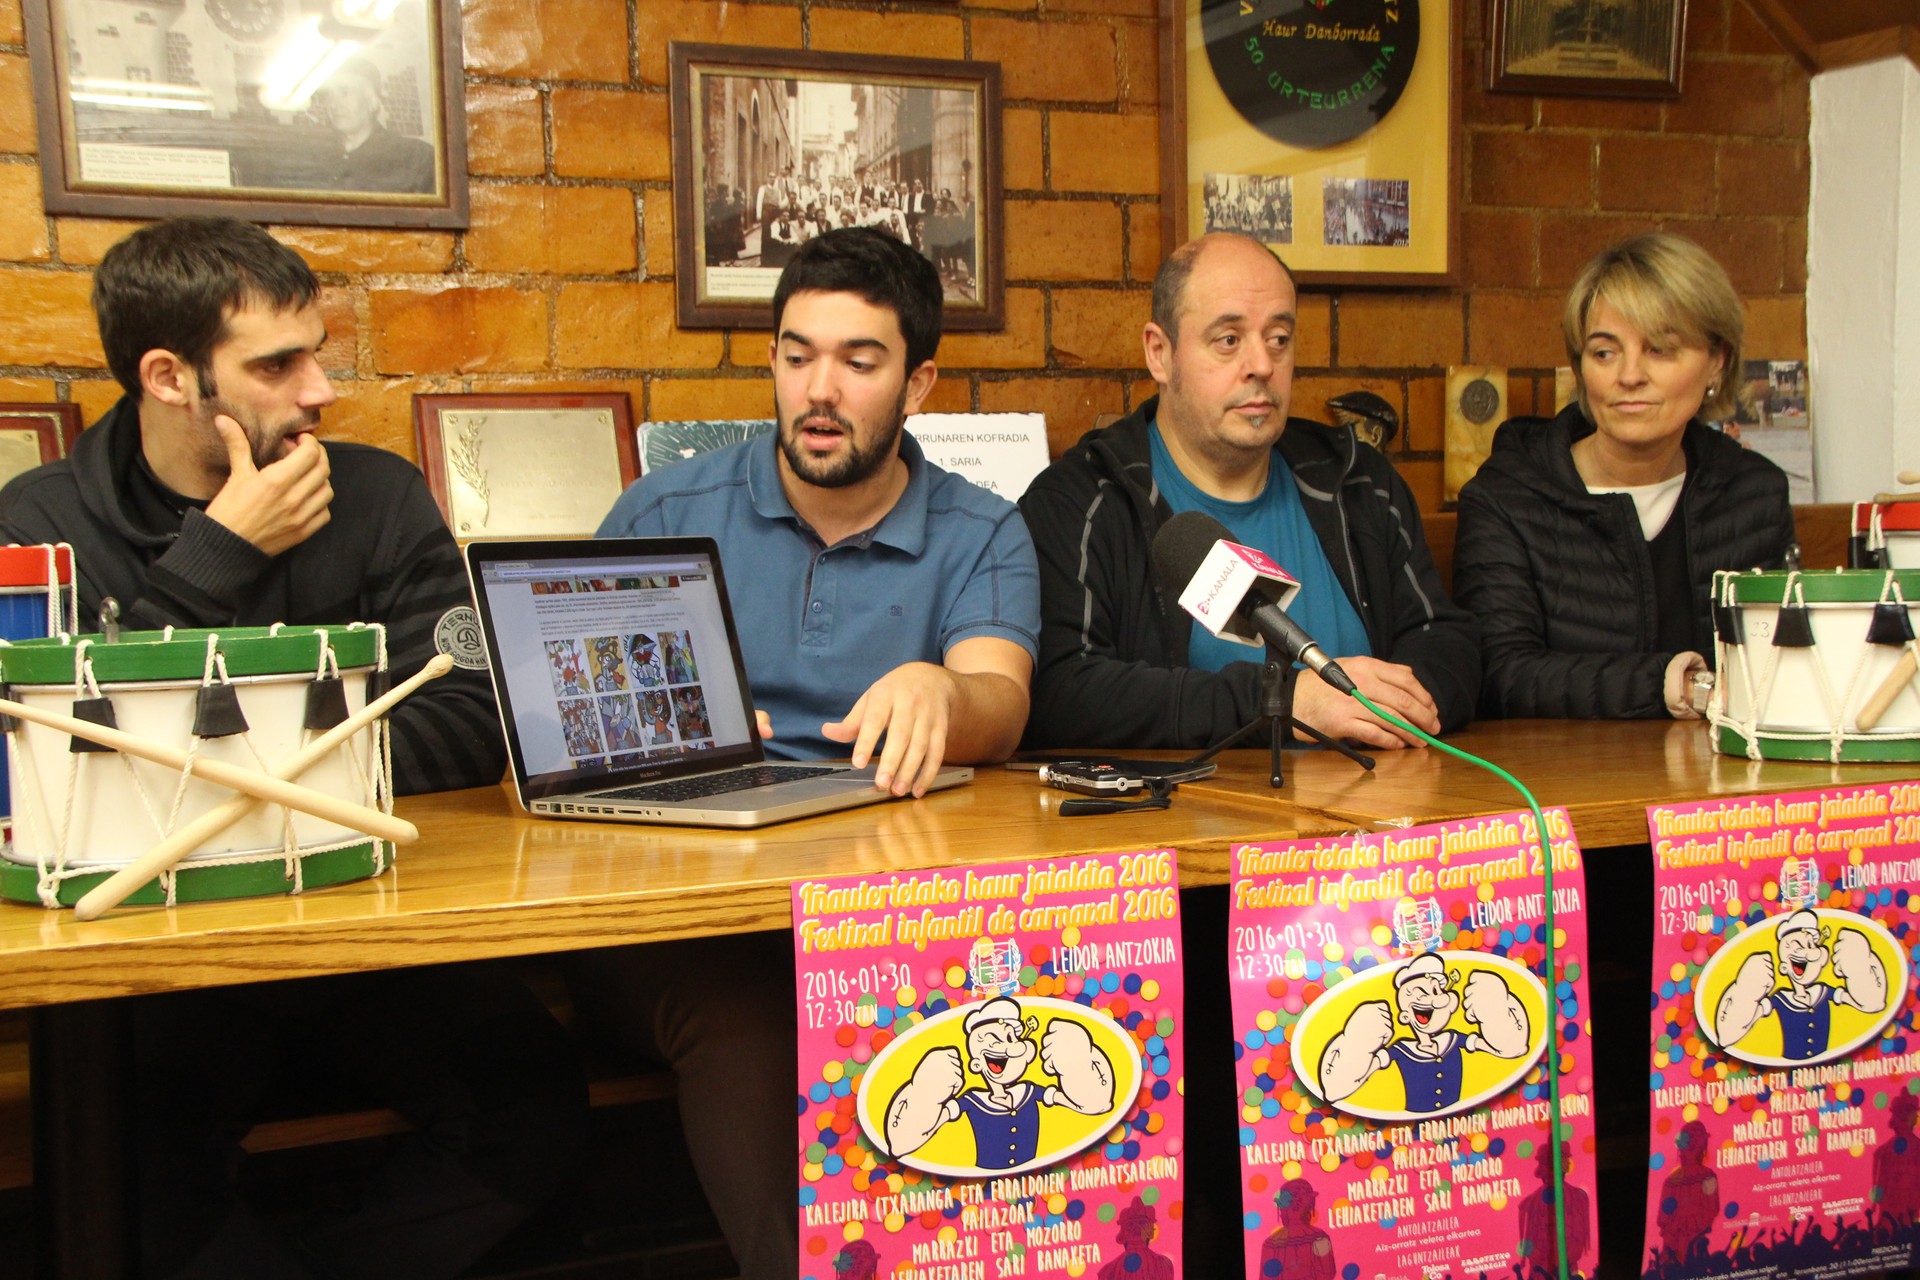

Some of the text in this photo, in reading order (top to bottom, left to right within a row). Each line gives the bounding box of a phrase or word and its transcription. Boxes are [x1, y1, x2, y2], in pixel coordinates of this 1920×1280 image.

[1262, 19, 1381, 42] Haur Danborrada
[1267, 45, 1395, 110] URTEURRENA
[976, 433, 1030, 443] KOFRADIA
[950, 457, 983, 466] SARIA
[441, 612, 481, 632] TERNU
[1383, 835, 1440, 865] haur
[1437, 818, 1521, 866] jaialdia
[1656, 836, 1725, 871] Festival
[1726, 829, 1792, 870] infantil
[1793, 827, 1815, 855] de
[964, 869, 1025, 902] haur
[1021, 858, 1116, 906] jaialdia
[1118, 851, 1173, 888] 2016
[1234, 875, 1316, 910] Festival
[1318, 867, 1406, 913] infantil
[1408, 864, 1435, 896] de
[1436, 848, 1528, 891] carnaval
[1841, 862, 1878, 890] LEIDOR
[798, 886, 1178, 954] Festival infantil de carnaval 2016
[1468, 886, 1582, 930] LEIDOR ANTOKIA
[1052, 936, 1177, 976] LEIDOR ANTZOKIA
[1769, 1071, 1789, 1092] ETA
[1769, 1088, 1827, 1115] PAILAZOAK
[1245, 1093, 1590, 1166] KALEJIRA (TXARANGA ETA ERRALDOIEN KONPARTSAEKIN)
[1733, 1106, 1864, 1143] MARRAZKI ETA MOZORRO
[1393, 1140, 1460, 1171] PAILAZOAK
[1716, 1127, 1878, 1169] LEHIAKETAREN SARI BANAKETA
[805, 1156, 1179, 1227] KALEJIRA (TXARANGA ETA ERRALDOIEN KONPARTSAREKIN)
[1346, 1156, 1504, 1202] MARRAZKI ETA MOZORRO
[962, 1201, 1035, 1232] PAILAZOAK
[1327, 1176, 1522, 1230] LEHIAKETAREN SARI BANAKETA
[912, 1219, 1083, 1265] MARRAZKI ETA MOZORRO
[1396, 1215, 1460, 1239] ANTOLATZAILEA
[1419, 1234, 1445, 1245] veleta
[1446, 1228, 1481, 1241] elkartea
[995, 1253, 1027, 1278] SARI
[1036, 1242, 1102, 1273] BANAKETA
[1396, 1244, 1461, 1268] LAGUNTZAILEAK
[1421, 1263, 1451, 1276] Tolosa
